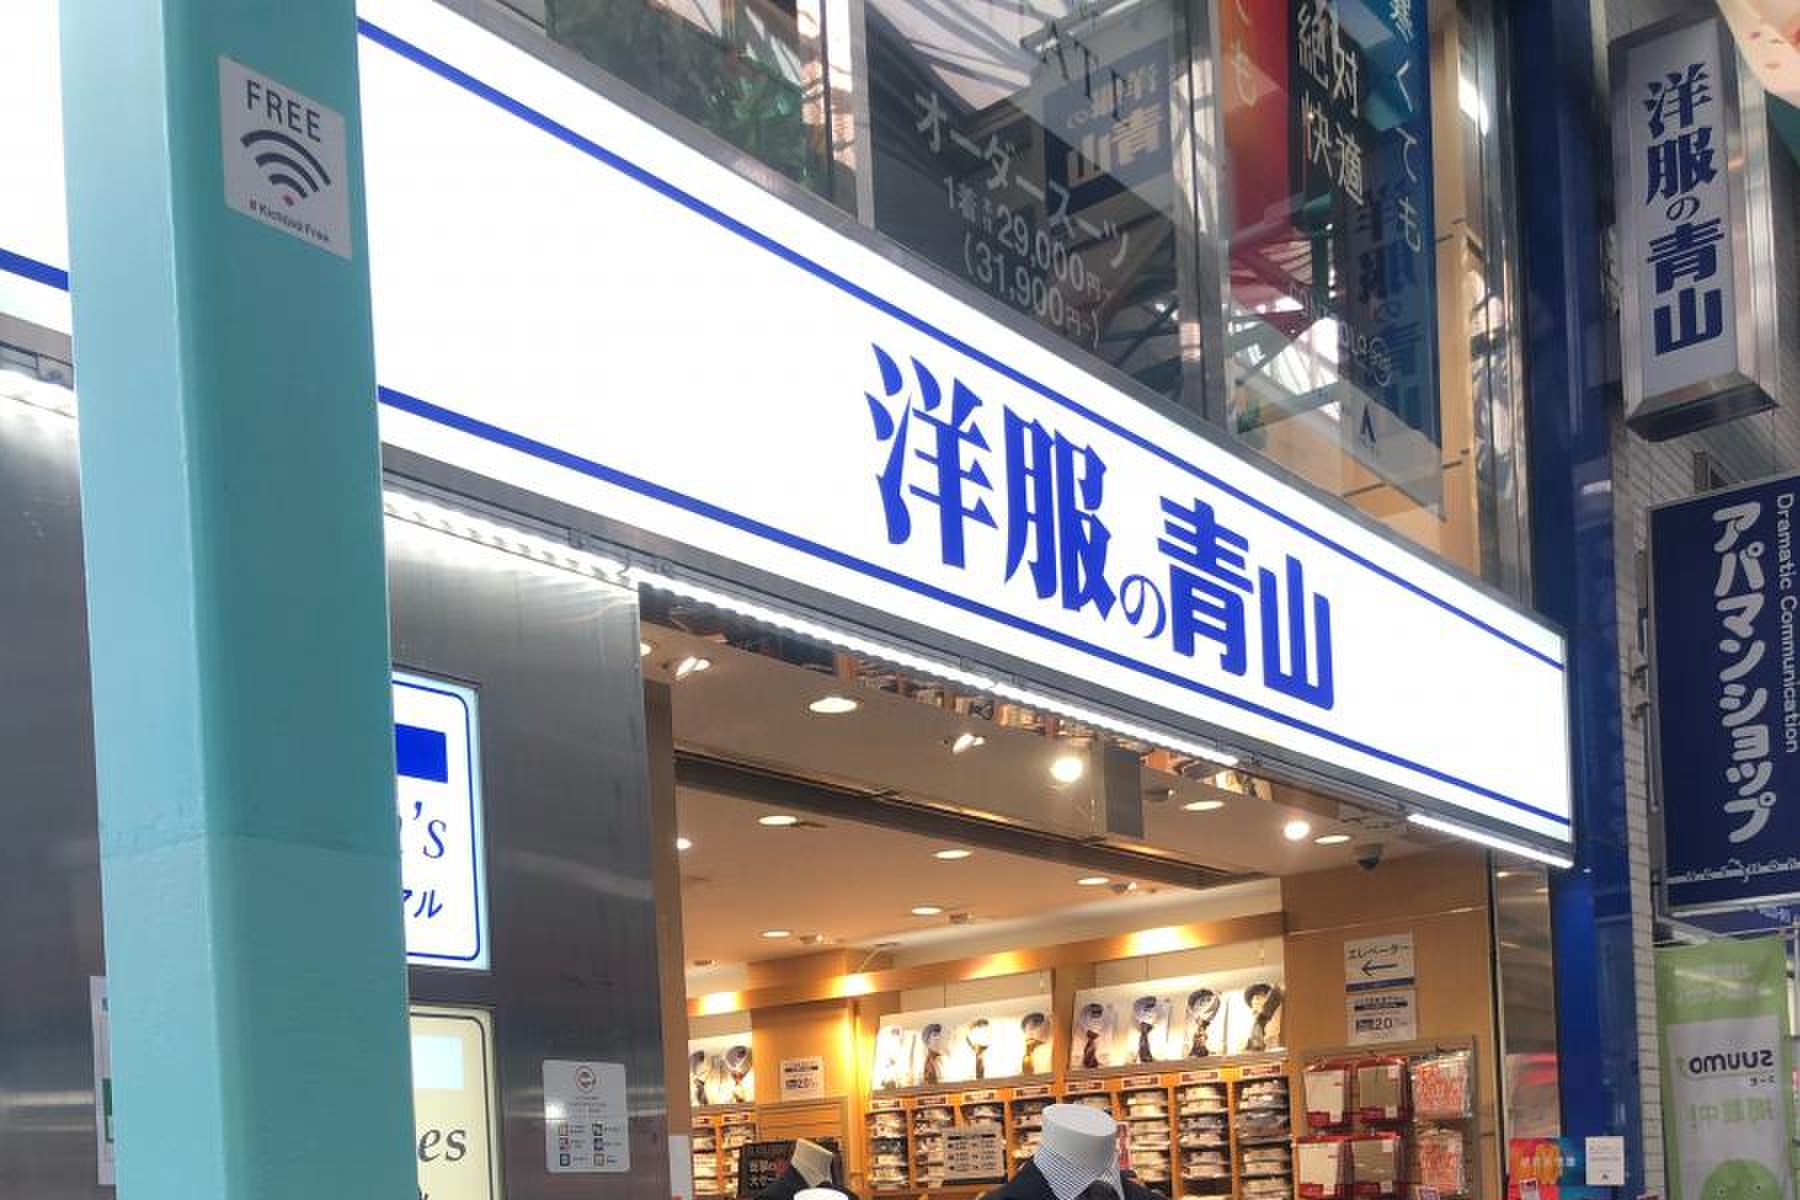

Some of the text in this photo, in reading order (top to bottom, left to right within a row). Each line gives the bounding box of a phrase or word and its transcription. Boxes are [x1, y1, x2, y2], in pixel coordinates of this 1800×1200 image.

[246, 79, 321, 143] FREE
[914, 92, 1128, 269] オーダースーツ
[1643, 63, 1725, 357] 洋服の青山
[863, 342, 1335, 711] 洋服の青山
[1776, 492, 1799, 755] Dramatic Communication
[1712, 500, 1777, 844] アパマンショップ
